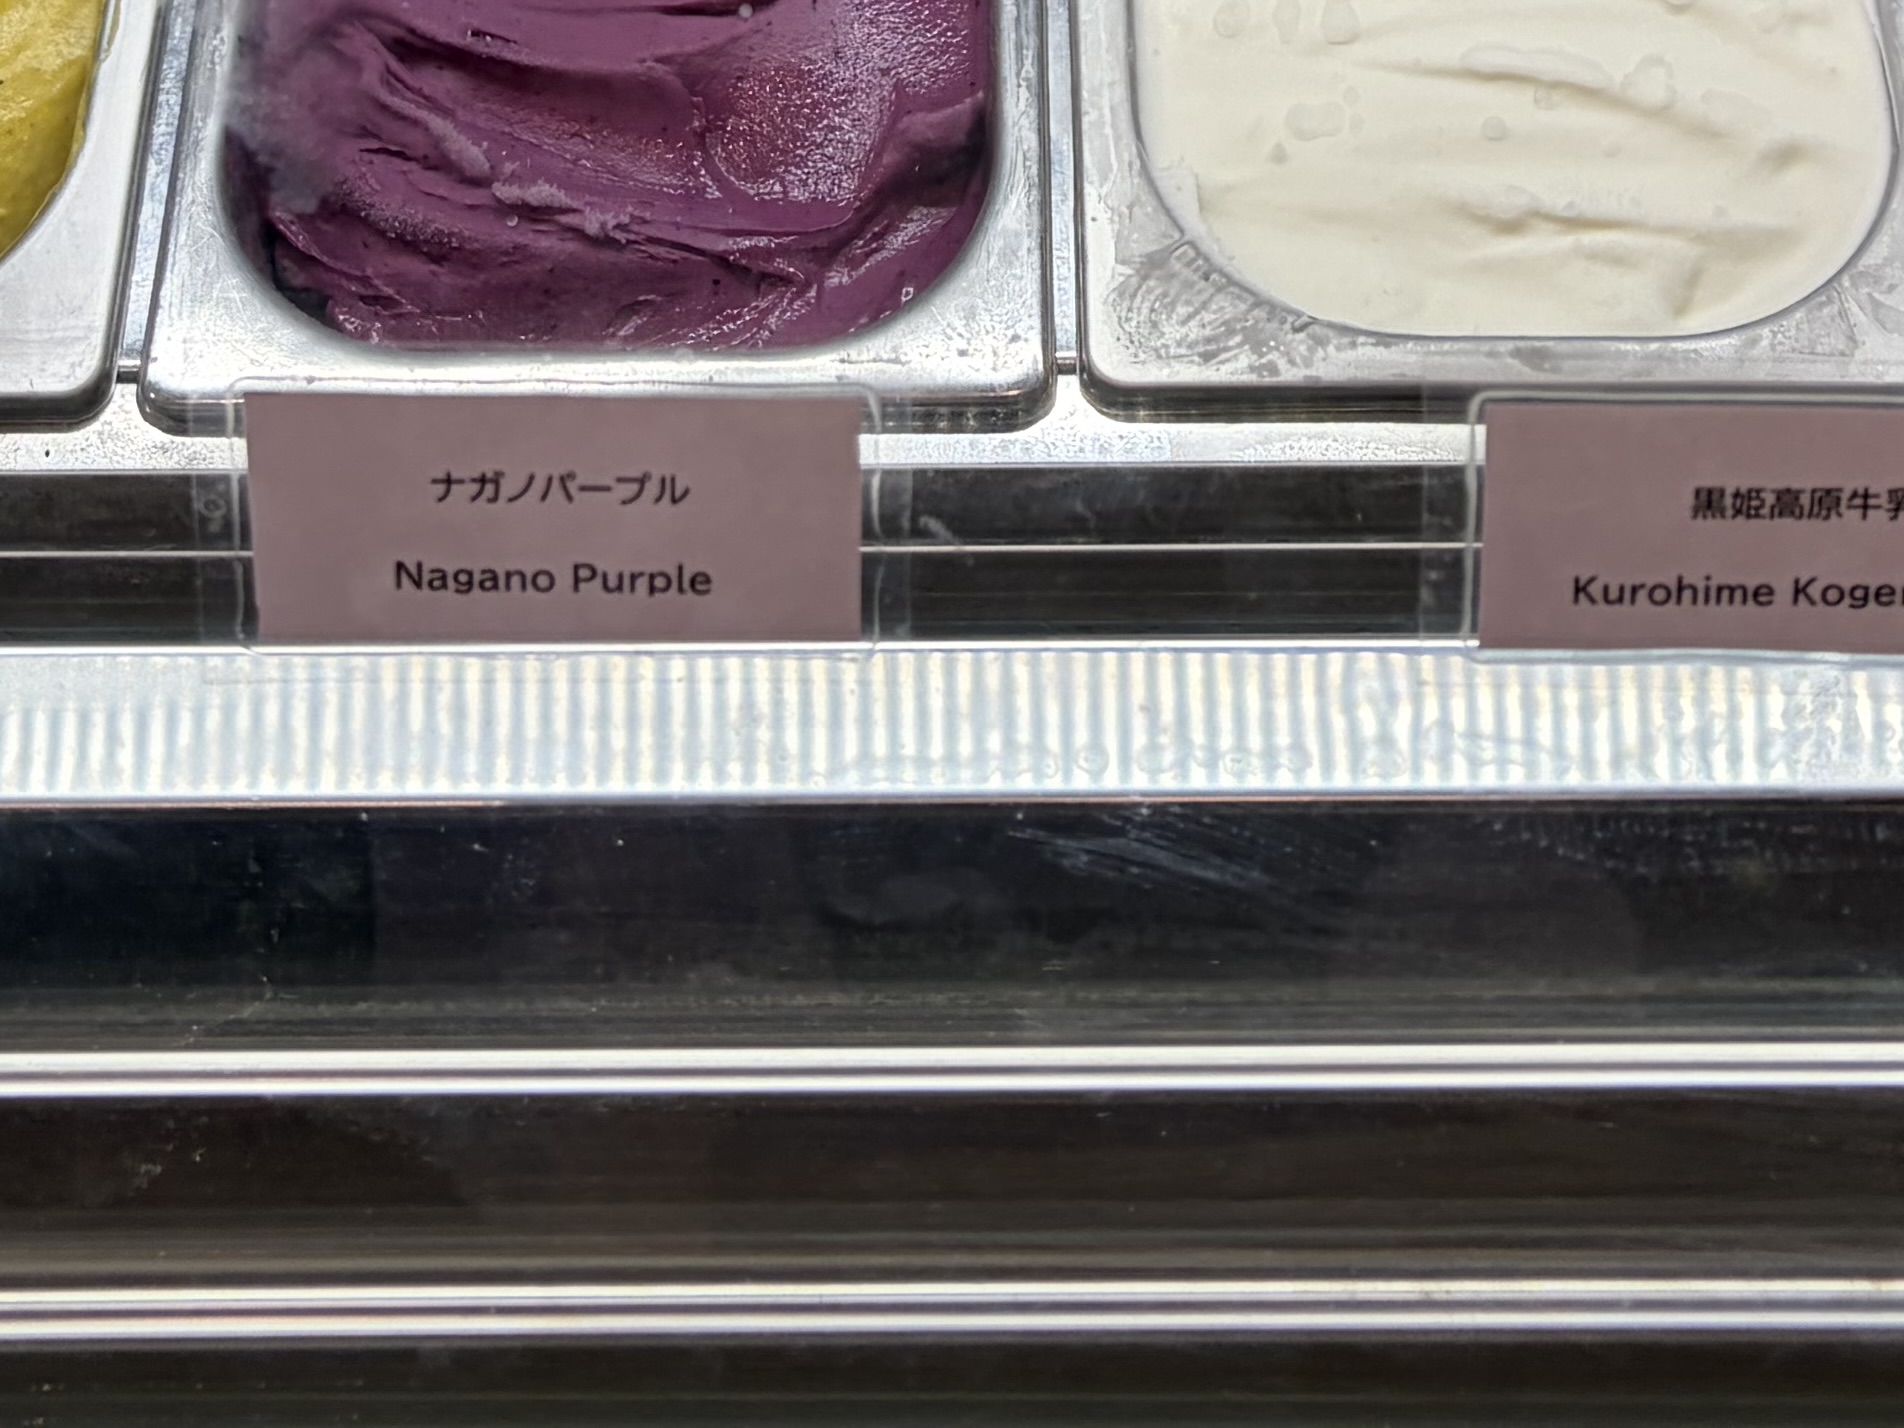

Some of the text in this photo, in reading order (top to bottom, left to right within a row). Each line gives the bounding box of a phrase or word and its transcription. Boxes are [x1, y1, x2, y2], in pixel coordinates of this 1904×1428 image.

[429, 469, 691, 506] ナガノパープル
[393, 559, 713, 598] Nagano Purple
[1572, 574, 1776, 608] Kurohime
